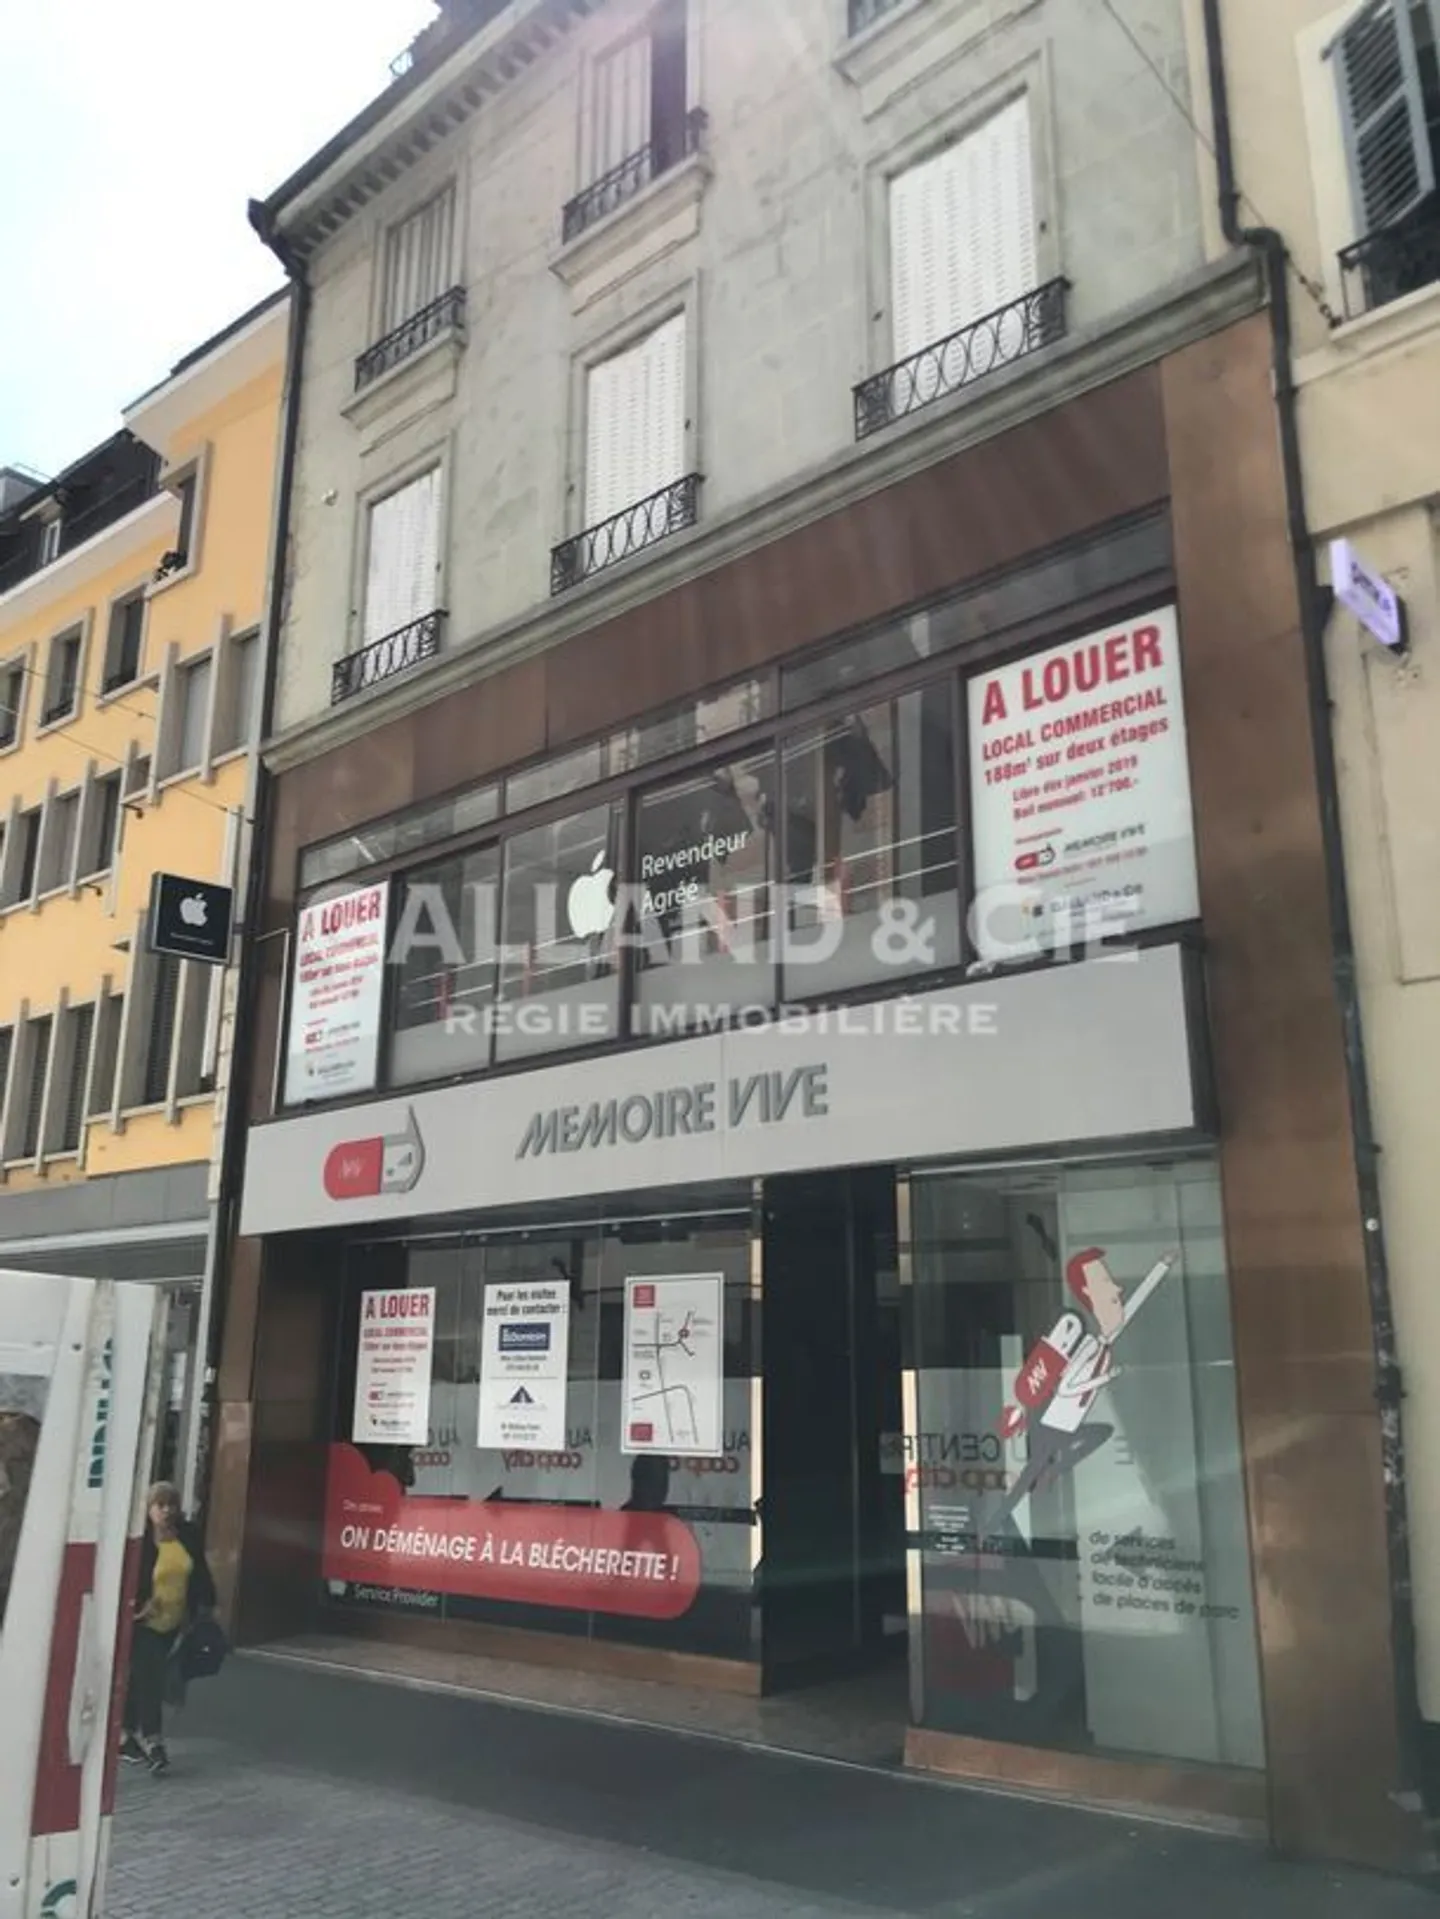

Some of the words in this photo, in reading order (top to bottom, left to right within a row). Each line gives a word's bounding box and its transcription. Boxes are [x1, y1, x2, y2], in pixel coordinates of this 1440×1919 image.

[981, 680, 1007, 726] A
[1021, 624, 1163, 712] LOUER
[982, 730, 1034, 762] LOCAL
[1040, 687, 1168, 743] COMMERCIAL
[1036, 750, 1061, 770] sur
[1066, 733, 1105, 760] deux
[641, 830, 749, 879] Revendeur
[302, 911, 314, 942] A
[321, 890, 381, 936] LOUER
[640, 876, 700, 915] Agréé
[515, 1082, 716, 1161] MEMOIRE
[726, 1063, 829, 1129] VIVE
[365, 1295, 376, 1320] A
[380, 1293, 429, 1319] LOUER
[340, 1525, 370, 1549] ON
[373, 1523, 477, 1562] DÉMÉNAGE
[479, 1531, 494, 1562] À
[500, 1539, 524, 1567] LA
[528, 1537, 667, 1581] BLÉCHERETTE
[670, 1554, 680, 1581] !
[1174, 1600, 1196, 1615] de
